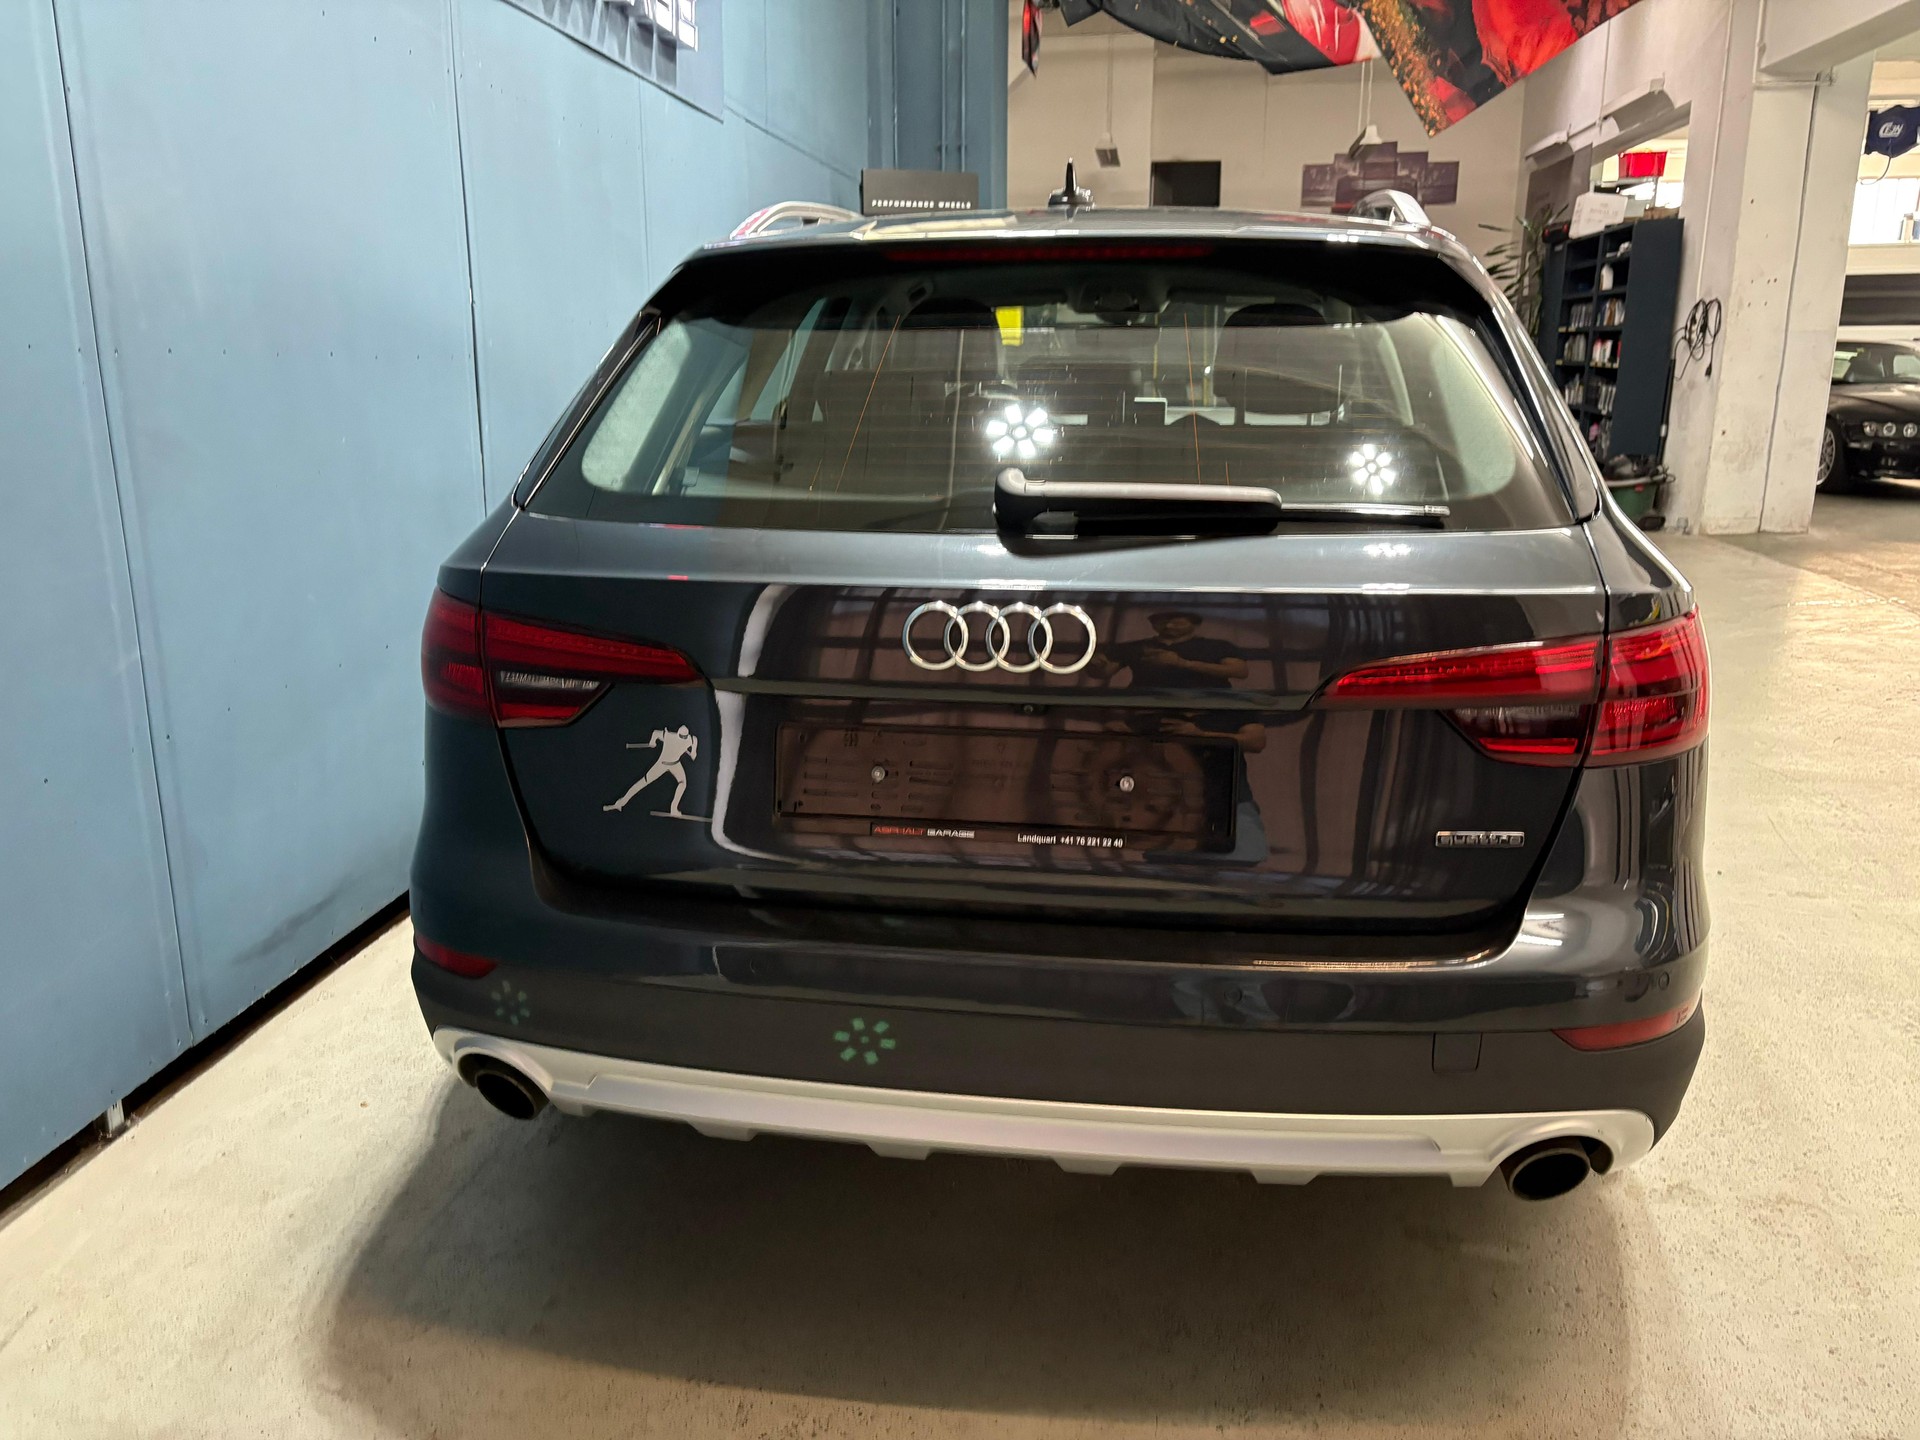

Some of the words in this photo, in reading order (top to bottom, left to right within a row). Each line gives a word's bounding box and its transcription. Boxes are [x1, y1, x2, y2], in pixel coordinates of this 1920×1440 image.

[871, 199, 935, 208] PERFORMANCE
[938, 201, 972, 210] WHEELS
[874, 825, 926, 836] ASPHALT
[927, 828, 975, 839] GARAGE
[1017, 833, 1057, 846] Landquart
[1060, 835, 1074, 846] +41
[1076, 836, 1086, 847] 76
[1086, 837, 1100, 847] 221
[1102, 838, 1112, 848] 22
[1113, 838, 1124, 849] 40
